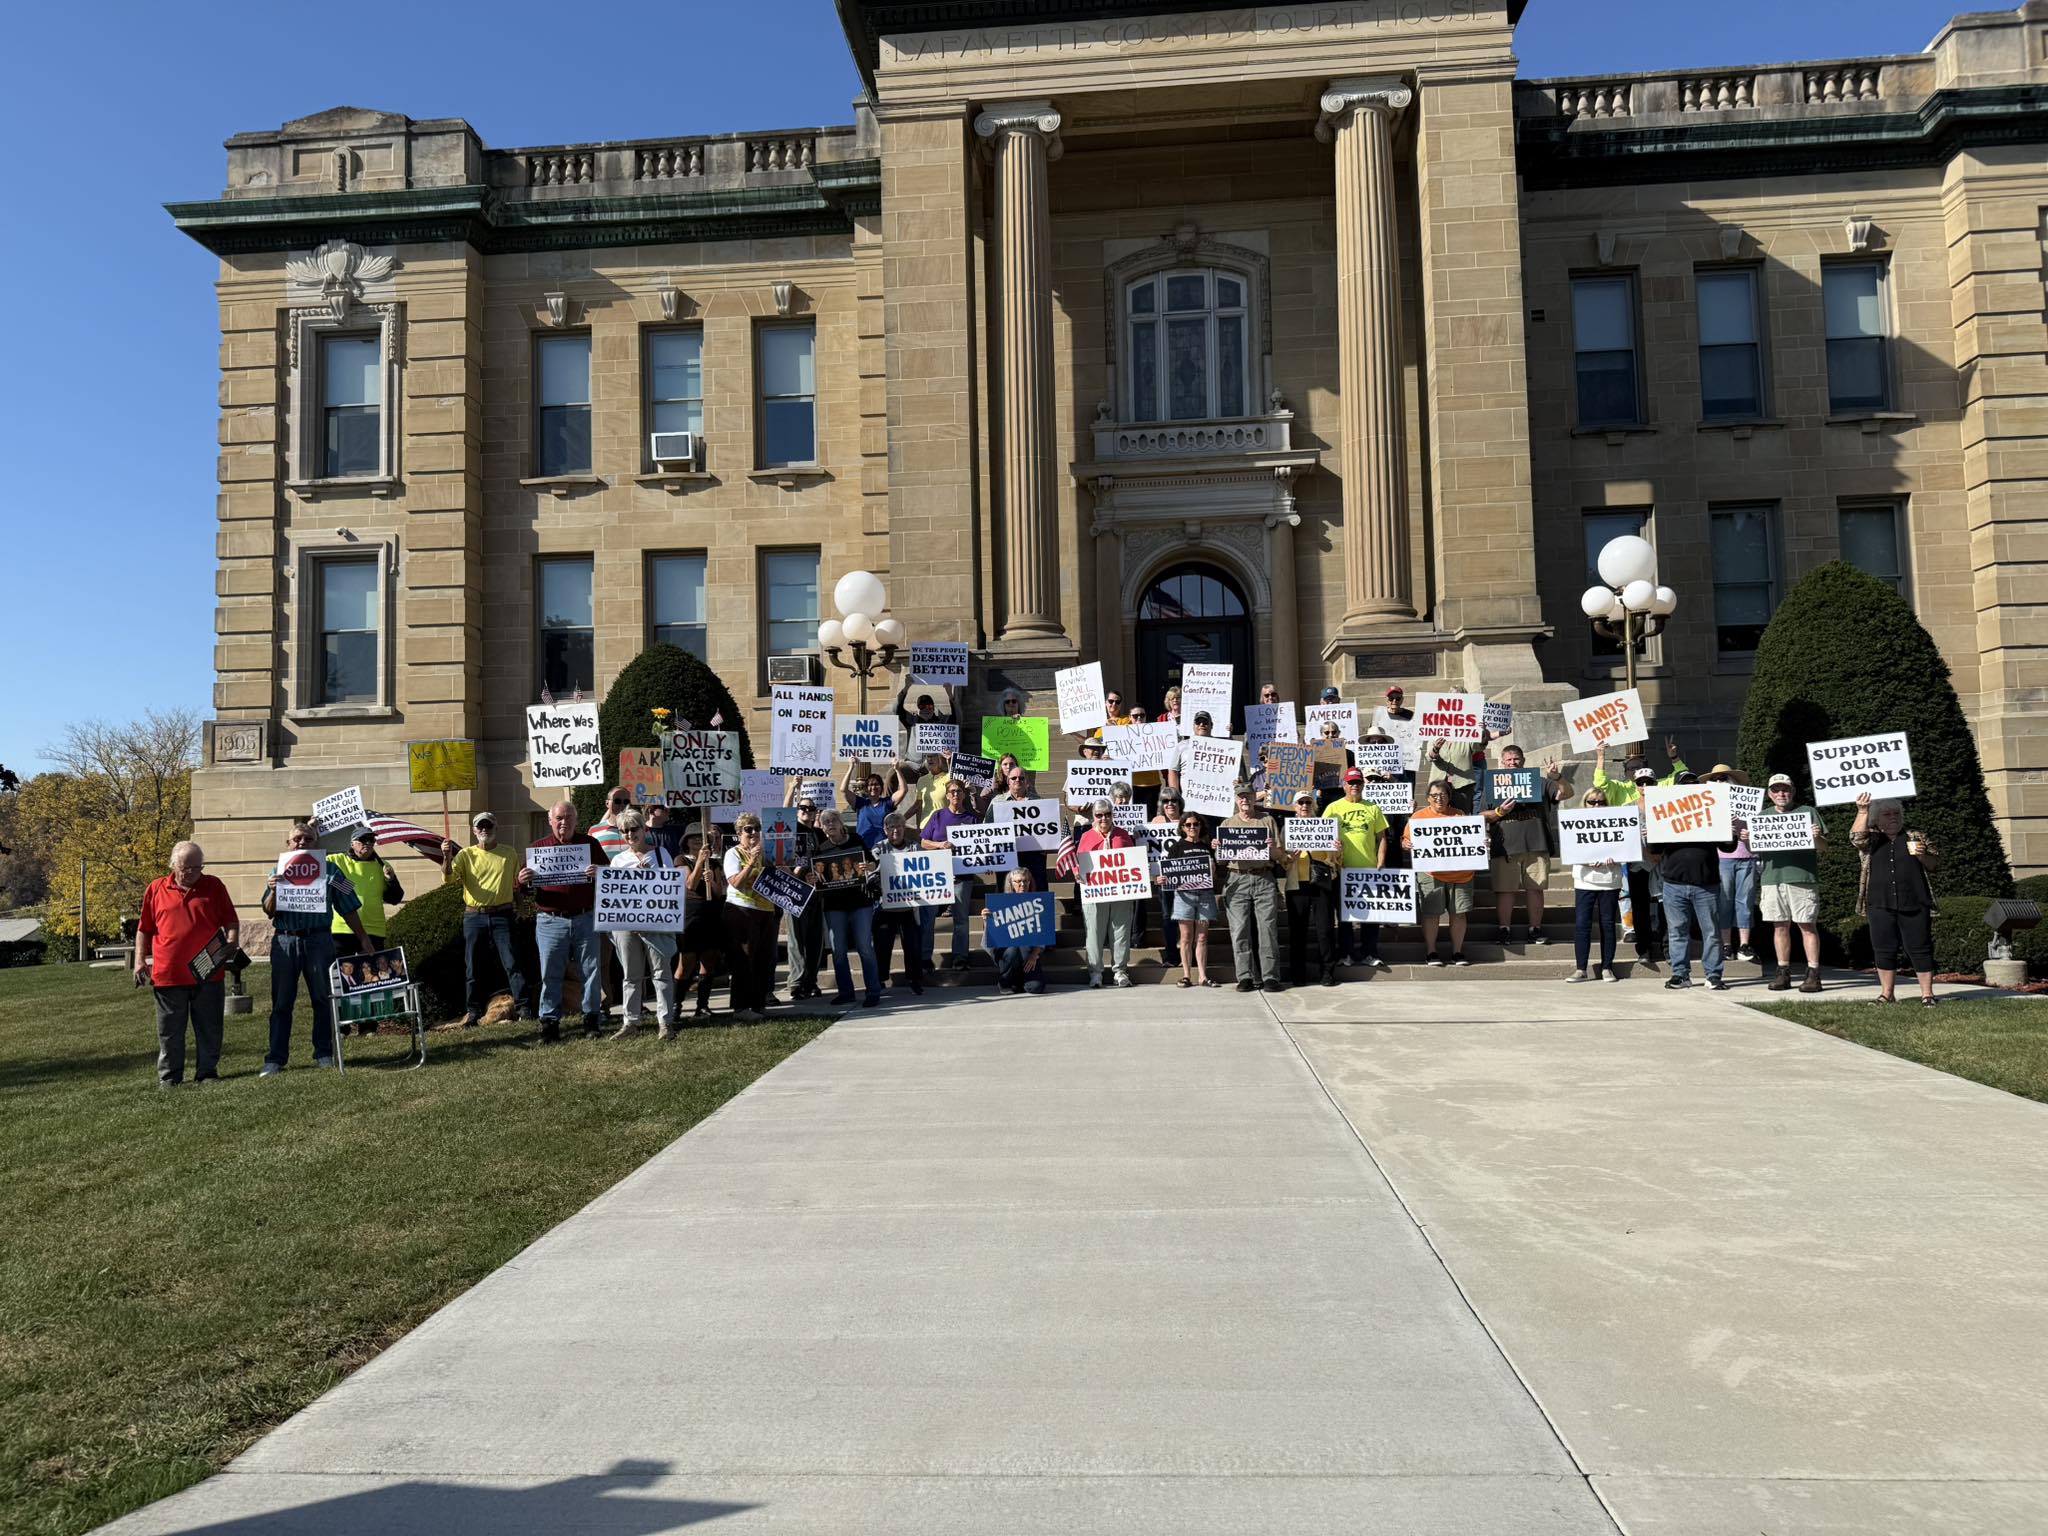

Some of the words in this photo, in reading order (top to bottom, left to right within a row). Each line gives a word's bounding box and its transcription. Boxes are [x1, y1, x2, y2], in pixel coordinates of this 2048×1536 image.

[895, 26, 1092, 62] LAFAYETTE
[1103, 17, 1237, 47] COUNTY
[1249, 7, 1362, 36] COURT
[1375, 0, 1492, 27] HOUSE
[912, 654, 966, 663] DESERVE
[912, 664, 965, 675] BETTER
[775, 690, 793, 700] ALL
[799, 691, 833, 702] HANDS
[1061, 684, 1094, 699] SMALL
[1258, 706, 1285, 716] LOVE
[1438, 698, 1463, 711] NO
[529, 712, 570, 729] Where
[572, 715, 593, 728] Was
[778, 709, 792, 717] ON
[799, 710, 827, 719] DECK
[1309, 709, 1352, 722] AMERICA
[1423, 713, 1476, 727] KINGS
[1573, 698, 1628, 732] HANDS
[792, 724, 811, 733] FOR
[856, 719, 879, 732] NO
[1126, 723, 1153, 738] NO
[1592, 713, 1628, 741] OFF!
[1419, 728, 1450, 737] SINCE
[1455, 729, 1479, 738] 1776
[532, 735, 560, 754] The
[561, 733, 600, 755] Guard
[673, 731, 726, 750] ONLY
[842, 734, 892, 747] KINGS
[1105, 734, 1175, 756] FAUX-KING
[1192, 740, 1224, 753] Release
[663, 748, 732, 761] FASCISTS
[839, 749, 868, 758] SINCE
[873, 749, 896, 758] 1776
[1269, 746, 1314, 762] FREEDOM
[1812, 739, 1903, 760] SUPPORT
[1194, 751, 1235, 766] EPSTEIN
[1840, 757, 1880, 771] OUR
[534, 761, 580, 781] January
[683, 761, 715, 772] ACT
[769, 766, 831, 777] DEMOCRACY
[1071, 767, 1128, 777] SUPPORT
[1192, 762, 1225, 774] FILES
[1280, 761, 1306, 775] FROM
[686, 773, 722, 787] LIKE
[1269, 773, 1308, 787] FASCISM
[1493, 773, 1512, 785] FOR
[1513, 773, 1531, 785] THE
[1814, 768, 1911, 790] SCHOOLS
[317, 795, 343, 808] STAND
[344, 789, 356, 798] UP
[666, 789, 741, 806] FASCISTS!
[1494, 785, 1533, 800] PEOPLE
[1740, 795, 1759, 803] OUT
[317, 802, 341, 815] SPEAK
[342, 796, 357, 806] OUT
[1652, 790, 1715, 820] HANDS
[1736, 803, 1757, 811] OUR
[318, 811, 340, 824] SAVE
[341, 805, 359, 815] OUR
[1012, 806, 1040, 819] NO
[1751, 815, 1788, 824] STAND
[1790, 814, 1806, 822] UP
[319, 811, 364, 833] DEMOCRACY
[1560, 817, 1638, 831] WORKERS
[1671, 807, 1712, 833] OFF!
[1787, 822, 1806, 830] OUT
[952, 827, 1010, 839] SUPPORT
[1413, 825, 1481, 837] SUPPORT
[1576, 830, 1625, 844] RULE
[1754, 833, 1782, 841] SAVE
[1784, 831, 1808, 839] OUR
[1222, 838, 1264, 846] DEMOCRACY
[1433, 837, 1463, 846] OUR
[1751, 839, 1812, 849] DEMOCRACY
[952, 842, 1014, 856] HEALTH
[1221, 849, 1234, 858] NO
[1413, 846, 1486, 859] FAMILIES
[534, 855, 576, 864] EPSTEIN
[904, 856, 929, 872] NO
[962, 854, 1006, 867] CARE
[1099, 853, 1125, 868] NO
[286, 863, 318, 877] STOP
[540, 863, 579, 873] SANTOS
[1163, 863, 1209, 874] IMMIGRANTS
[602, 869, 656, 880] STAND
[660, 871, 681, 881] UP
[889, 872, 946, 890] KINGS
[1086, 868, 1142, 886] KINGS
[1180, 873, 1209, 884] KINGS
[1346, 872, 1409, 883] SUPPORT
[601, 883, 648, 895] SPEAK
[653, 884, 681, 895] OUT
[757, 882, 770, 896] NO
[764, 874, 803, 902] FARMERS
[1084, 886, 1118, 898] SINCE
[1122, 884, 1147, 894] 1776
[1345, 883, 1411, 899] FARM
[887, 890, 921, 902] SINCE
[925, 888, 951, 899] 1776
[288, 903, 316, 911] FAMILIES
[601, 898, 642, 909] SAVE
[646, 899, 679, 910] OUR
[1344, 900, 1413, 911] WORKERS
[598, 912, 681, 923] DEMOCRACY
[993, 897, 1045, 928] HANDS
[1007, 913, 1042, 939] OFF!
